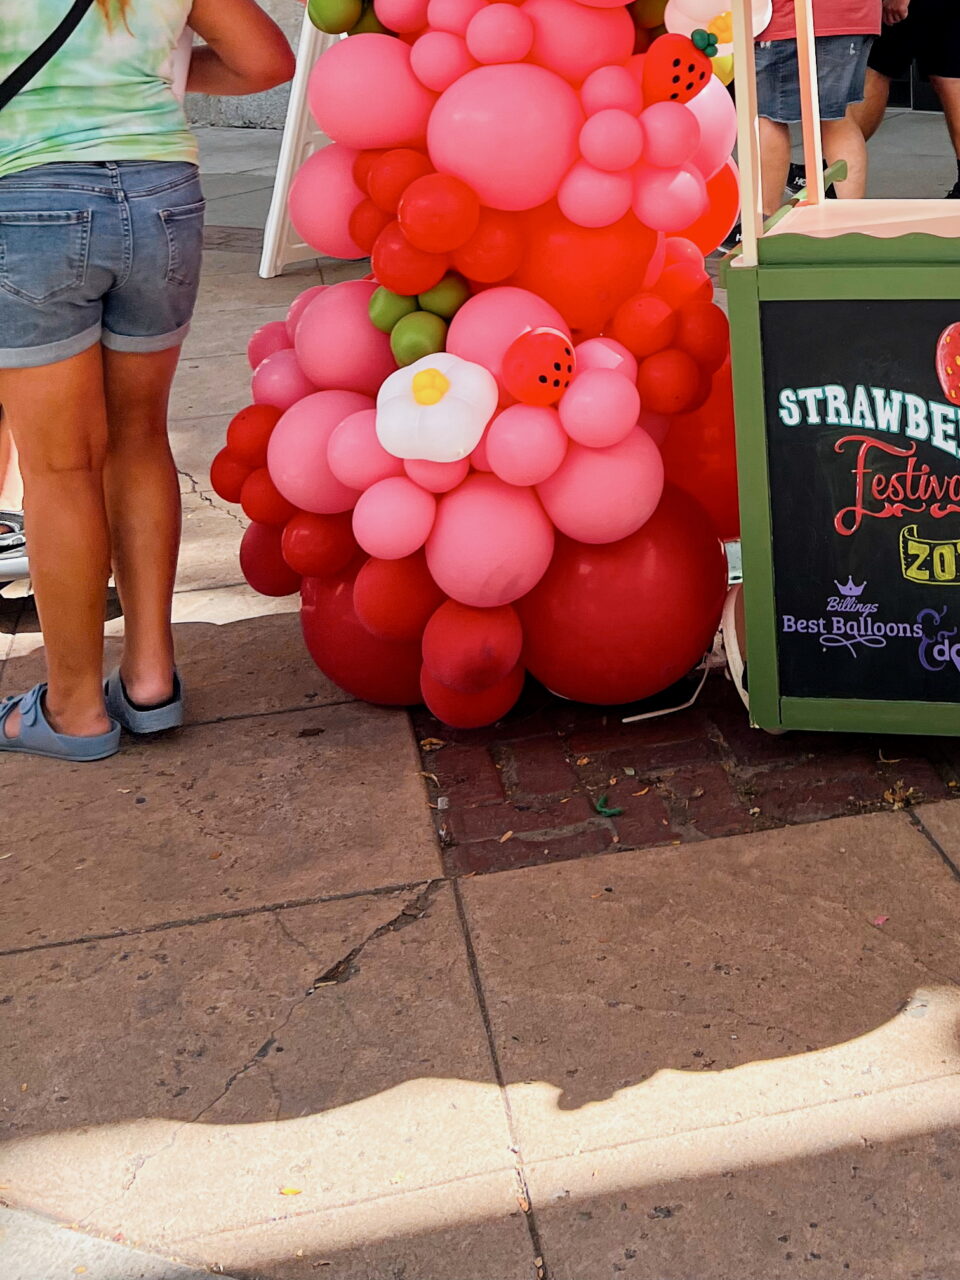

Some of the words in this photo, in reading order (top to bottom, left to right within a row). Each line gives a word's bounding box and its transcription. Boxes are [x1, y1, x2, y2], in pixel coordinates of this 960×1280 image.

[826, 596, 879, 617] Billings
[782, 615, 828, 634] Best
[831, 617, 923, 638] Balloons
